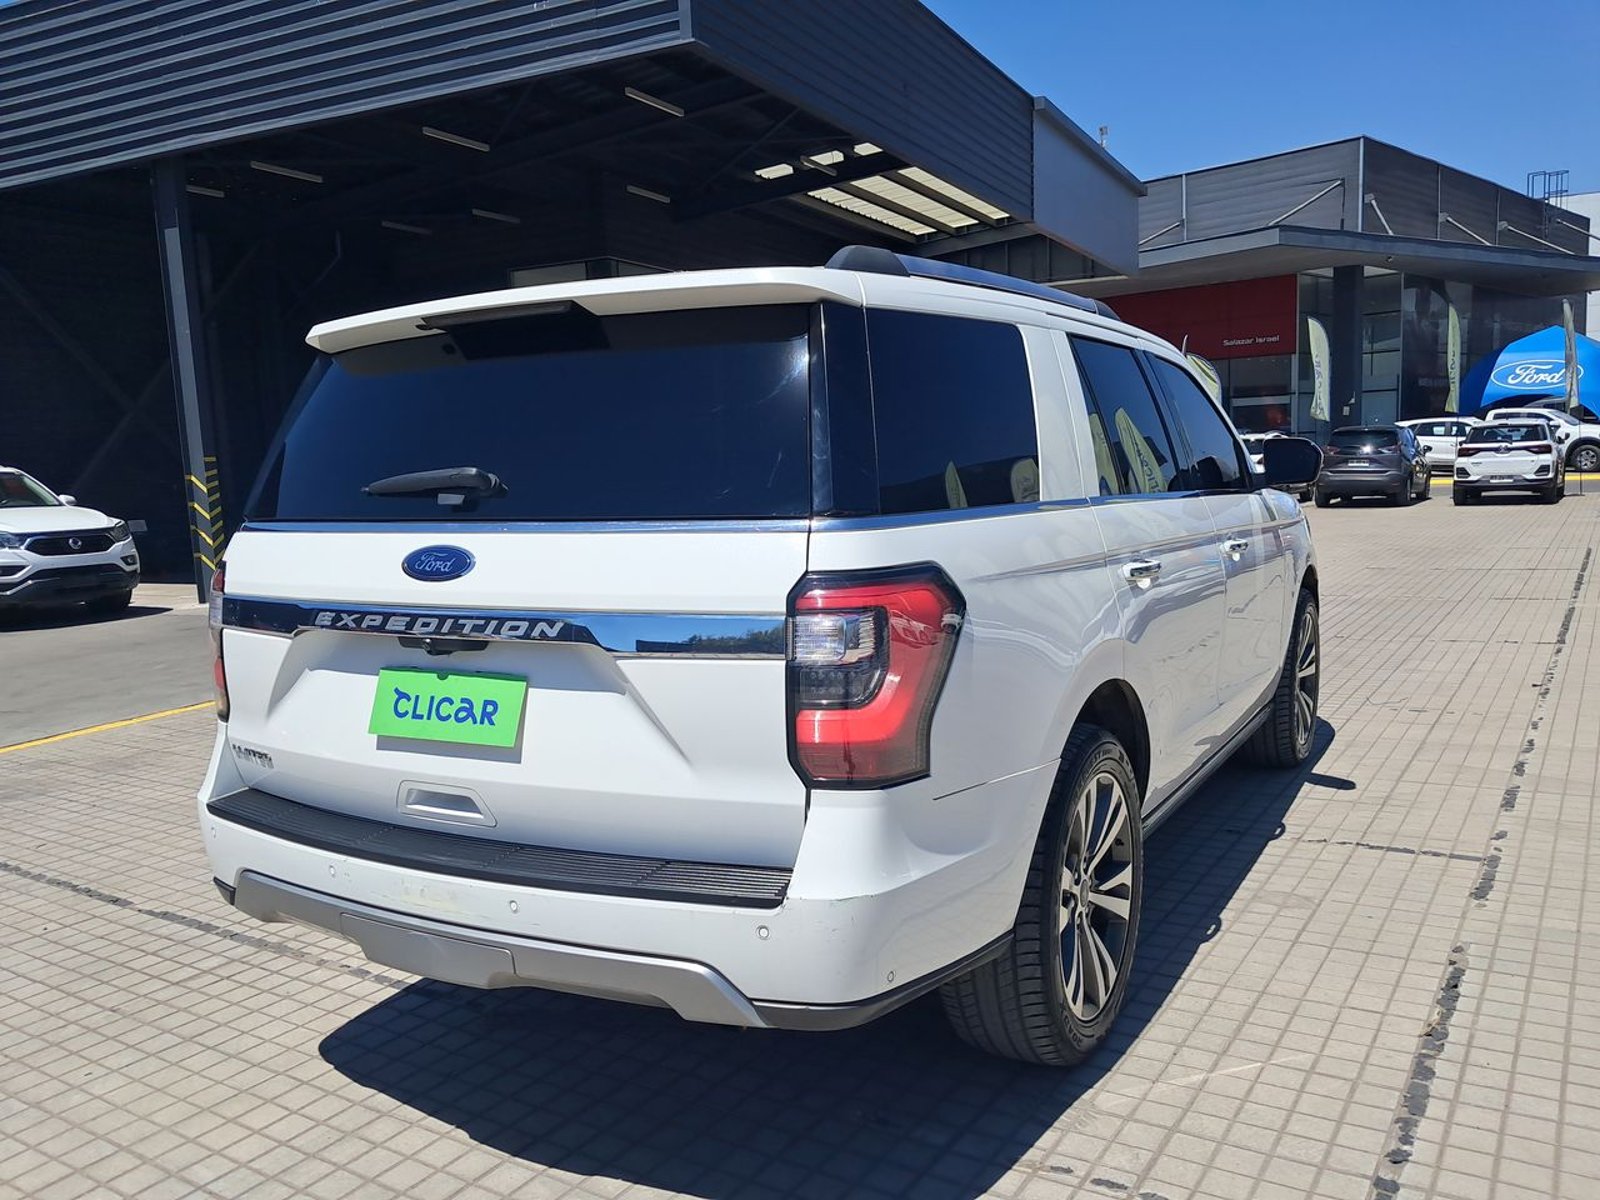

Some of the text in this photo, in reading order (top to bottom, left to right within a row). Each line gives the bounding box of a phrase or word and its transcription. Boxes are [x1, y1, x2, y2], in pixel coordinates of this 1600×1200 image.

[1222, 334, 1280, 347] Salazar Israel
[1507, 364, 1566, 384] Ford
[414, 551, 457, 573] Ford
[313, 610, 566, 638] EXPEDITION
